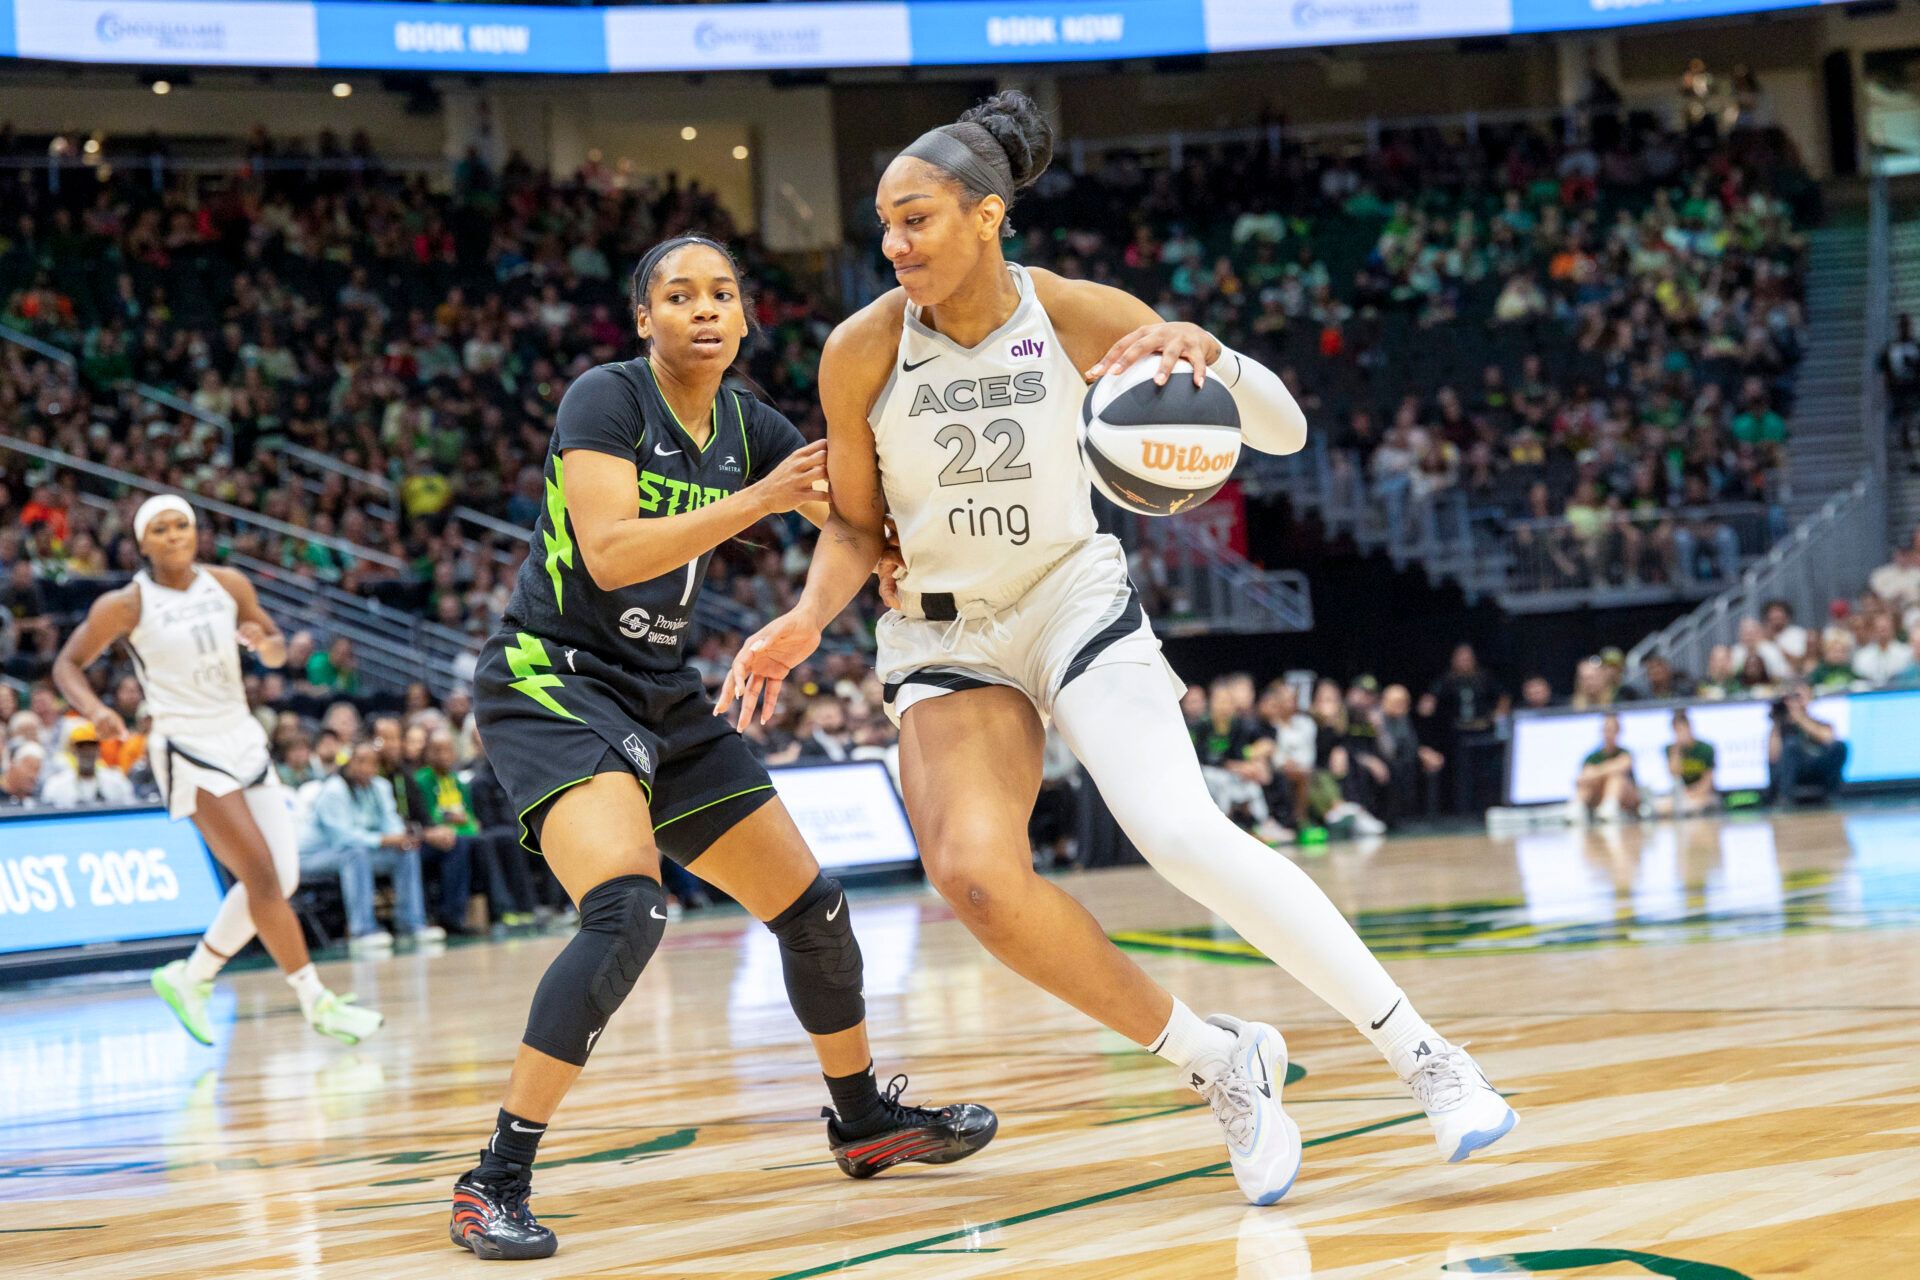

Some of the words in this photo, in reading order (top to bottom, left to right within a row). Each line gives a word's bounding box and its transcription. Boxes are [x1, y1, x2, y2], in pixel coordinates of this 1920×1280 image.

[395, 20, 464, 53] BOOK
[468, 24, 529, 54] NOW
[987, 15, 1057, 47] BOOK
[1061, 12, 1124, 45] NOW
[1010, 339, 1044, 358] ally
[908, 371, 1047, 417] ACES
[934, 418, 1032, 487] 22
[1141, 439, 1235, 472] Wilson
[638, 470, 731, 516] STO
[948, 498, 1030, 546] ring
[647, 631, 678, 645] SWEDISH
[0, 854, 76, 914] UST
[78, 848, 179, 906] 2025
